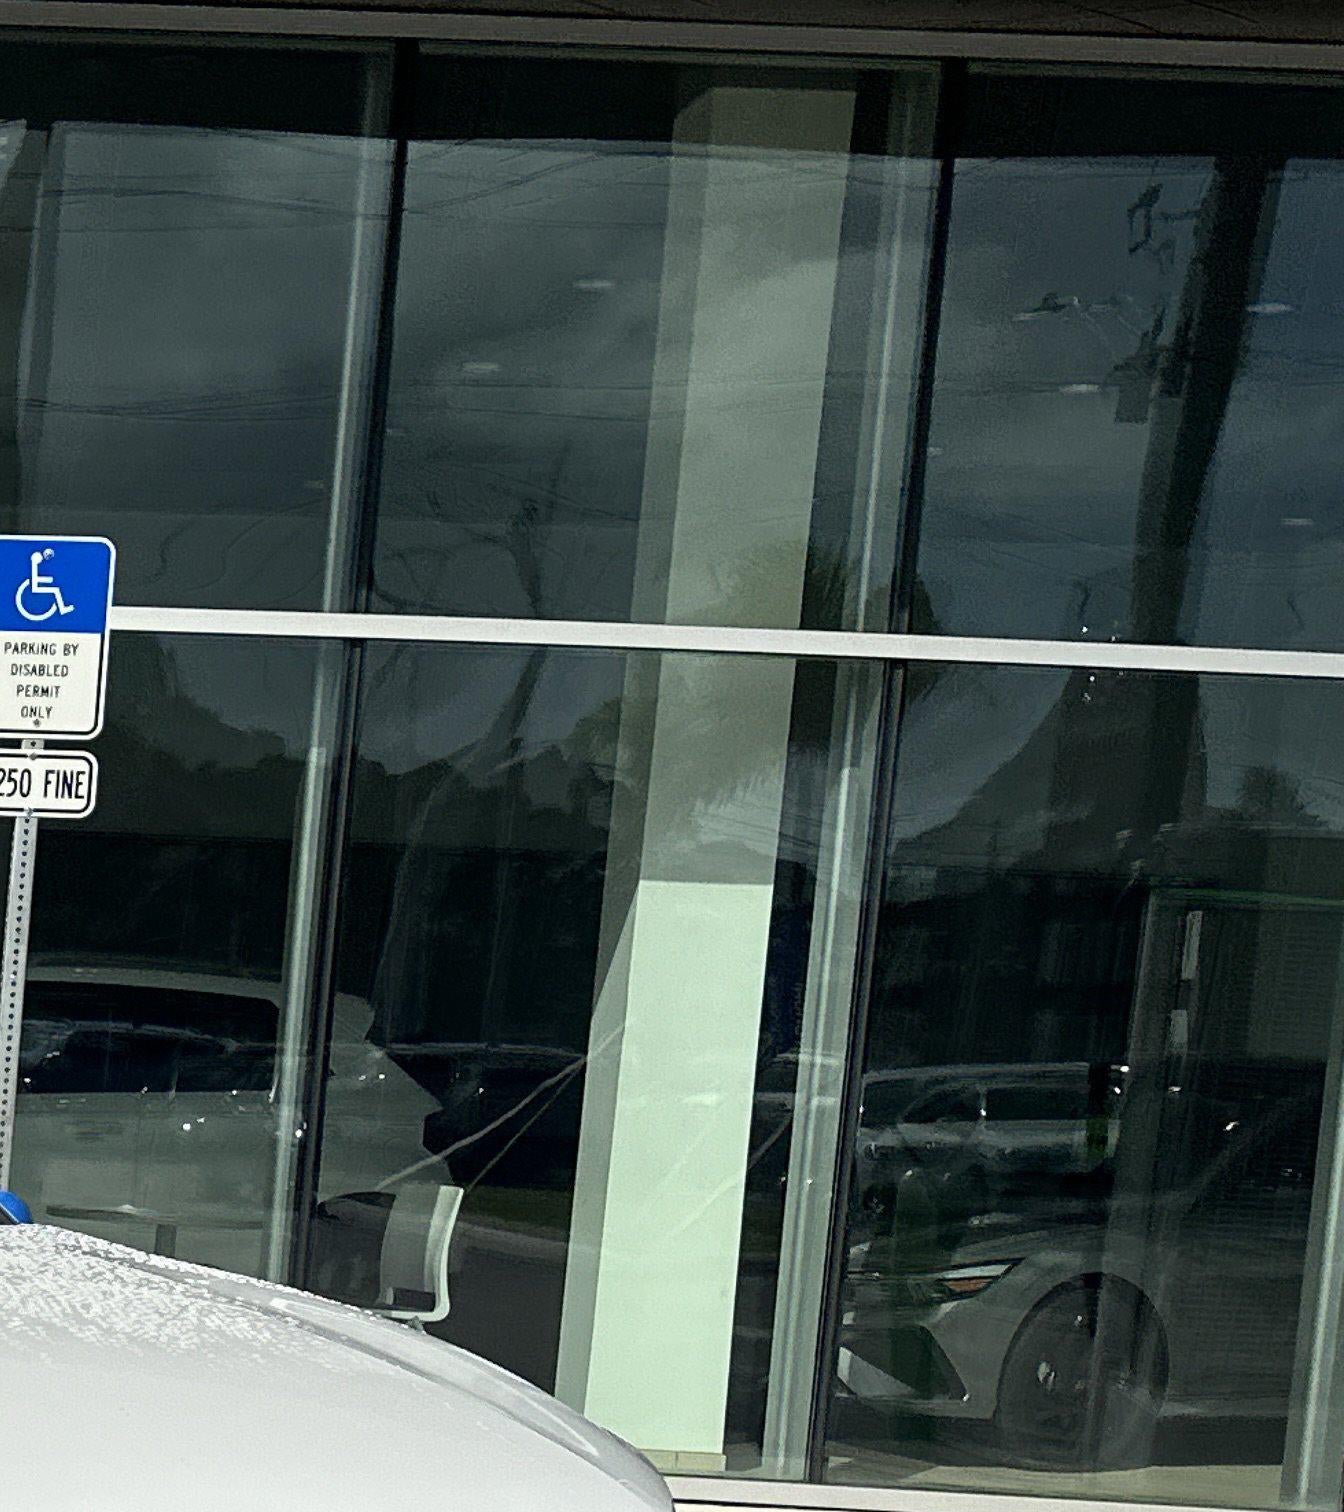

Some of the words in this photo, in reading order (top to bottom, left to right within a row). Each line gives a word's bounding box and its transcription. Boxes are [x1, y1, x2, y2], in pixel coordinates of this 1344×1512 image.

[4, 641, 57, 656] PARKING
[63, 643, 80, 656] BY
[10, 663, 69, 677] DISABLED
[16, 684, 61, 699] PERMIT
[20, 705, 53, 719] ONLY
[43, 769, 86, 799] FINE
